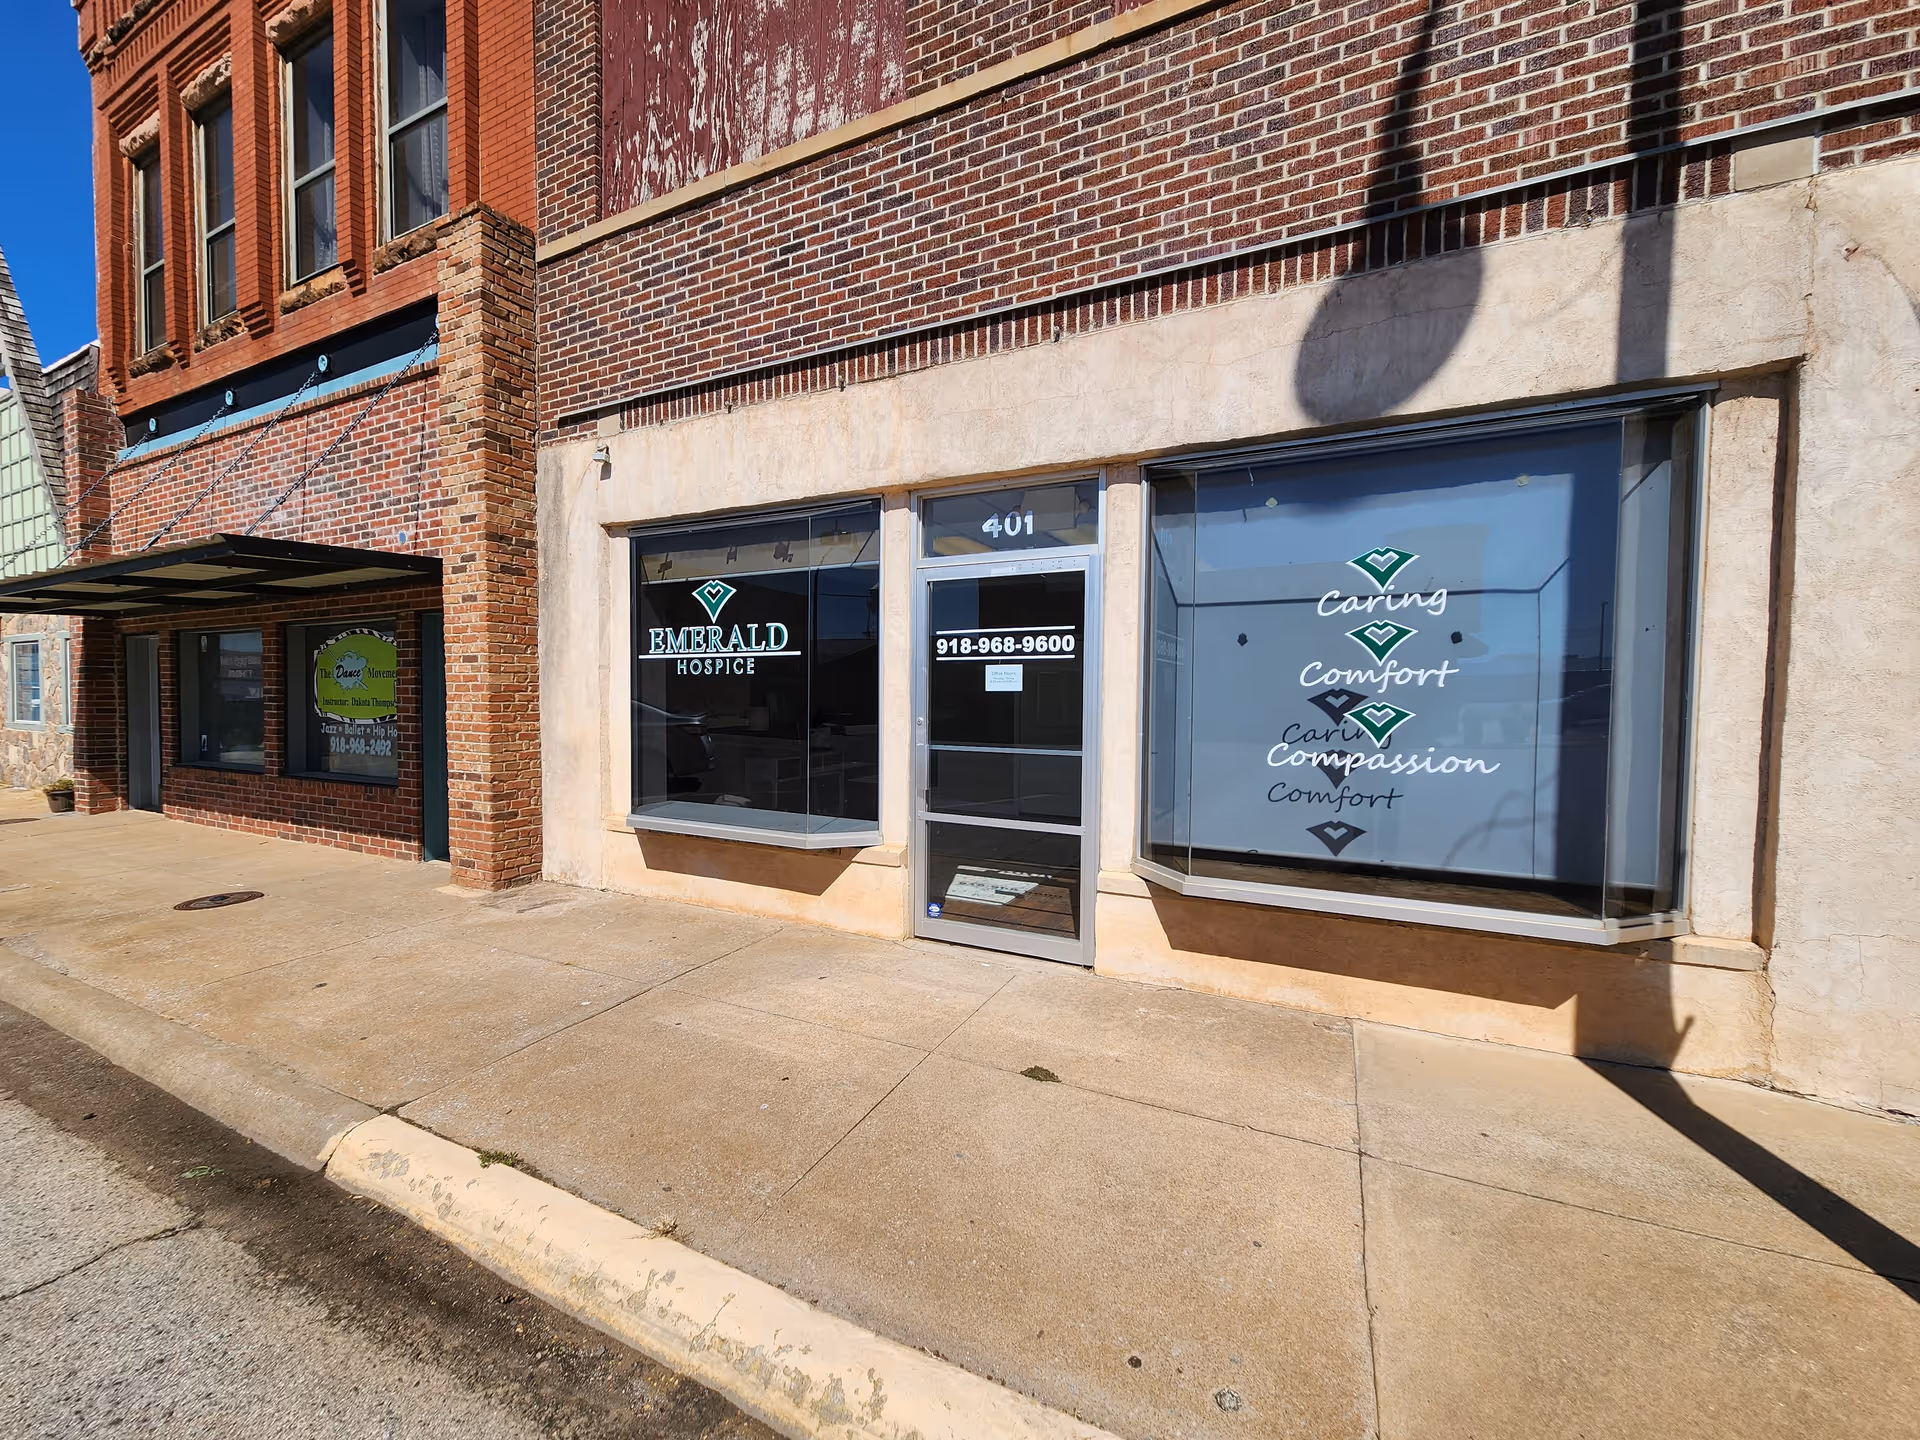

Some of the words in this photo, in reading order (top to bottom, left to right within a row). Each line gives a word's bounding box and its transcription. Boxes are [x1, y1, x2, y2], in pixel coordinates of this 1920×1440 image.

[981, 510, 1034, 538] 401
[1317, 584, 1448, 617] Caring
[648, 622, 789, 654] EMERALD
[936, 634, 1076, 655] 918-968-9600
[319, 668, 331, 679] The
[335, 664, 361, 679] Dance
[677, 657, 755, 675] HOSPICE
[1299, 659, 1461, 693] Comfort
[322, 696, 349, 706] Instructor:
[352, 697, 371, 707] Dakota
[320, 722, 337, 734] Jazz
[344, 723, 365, 736] Ballet
[372, 725, 386, 739] Hip
[330, 735, 392, 757] 918-968-2492
[1266, 742, 1501, 776] Compassion
[1267, 782, 1404, 813] Comfort
